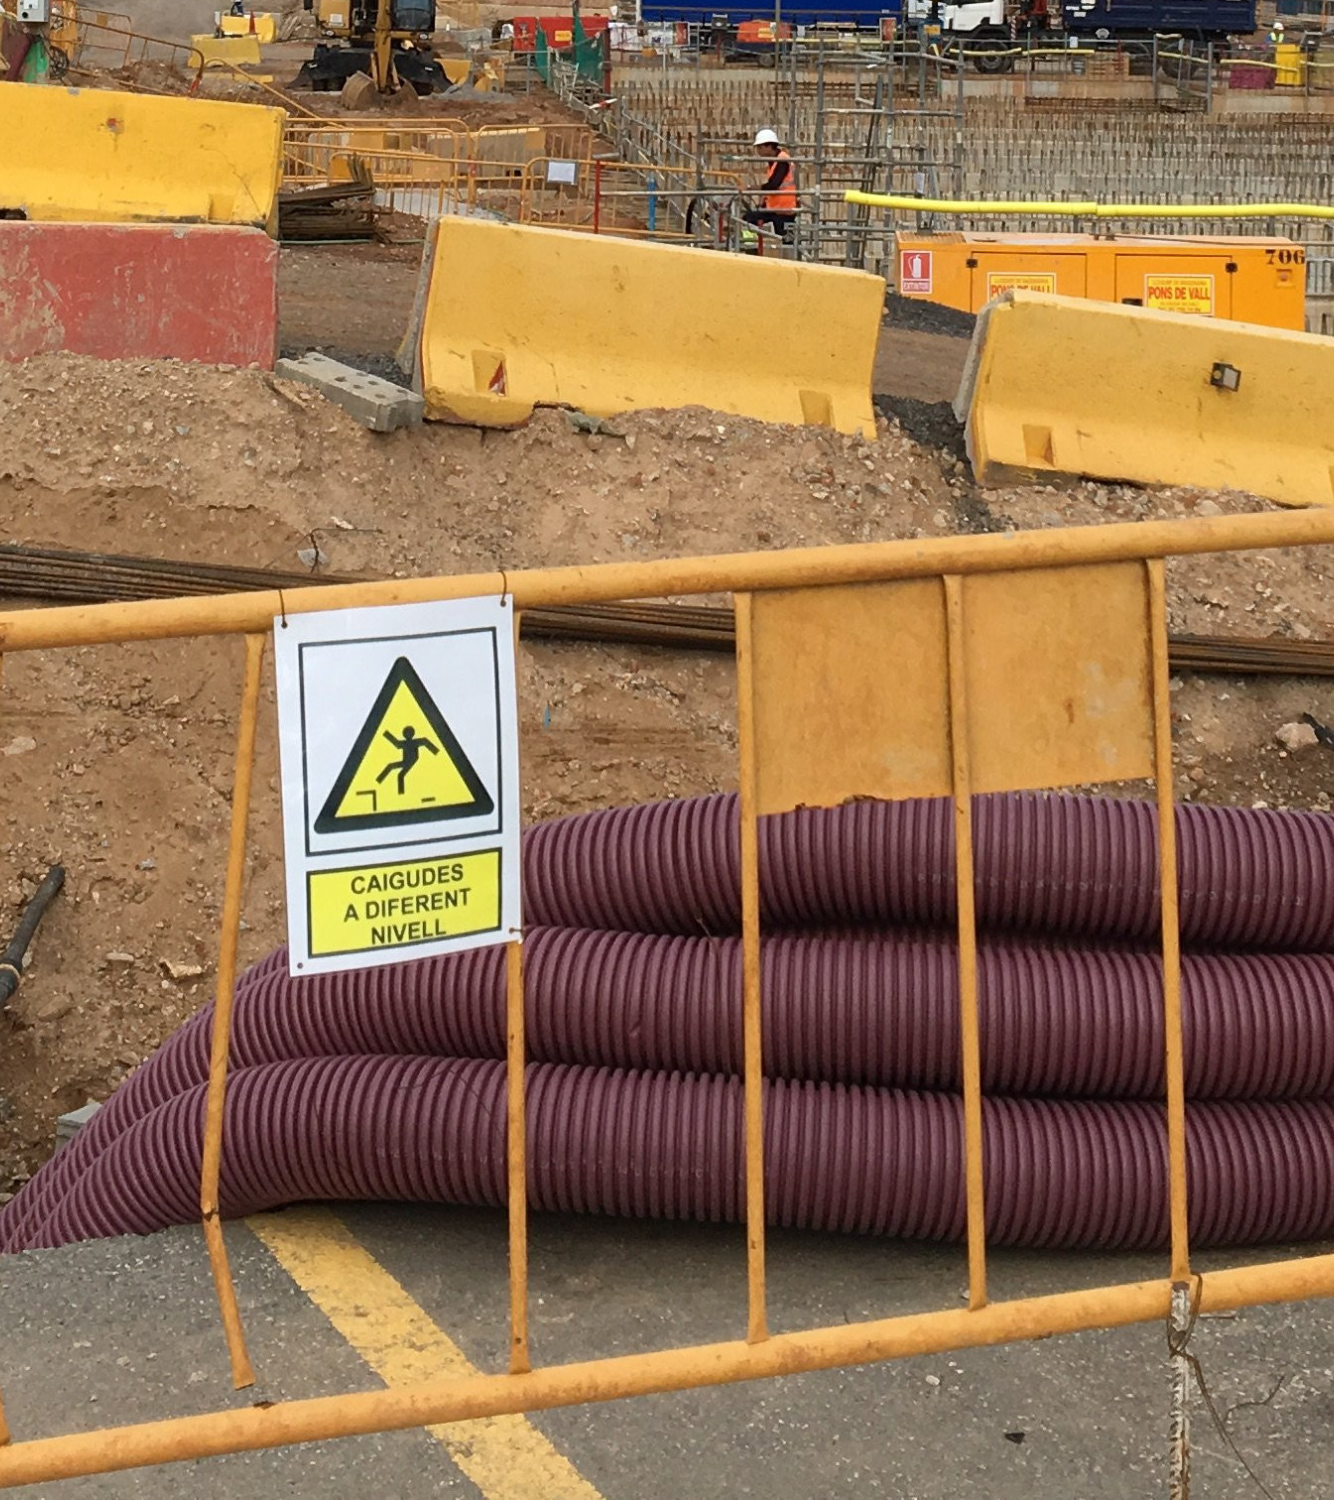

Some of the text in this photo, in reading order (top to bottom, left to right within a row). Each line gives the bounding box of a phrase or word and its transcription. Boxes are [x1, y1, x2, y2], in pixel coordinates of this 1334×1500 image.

[1265, 249, 1305, 265] 706
[1147, 286, 1211, 301] PONS DE VALL
[350, 863, 464, 894] CAIGUDES
[343, 888, 471, 922] A DIFERENT
[371, 918, 447, 945] NIVELL
